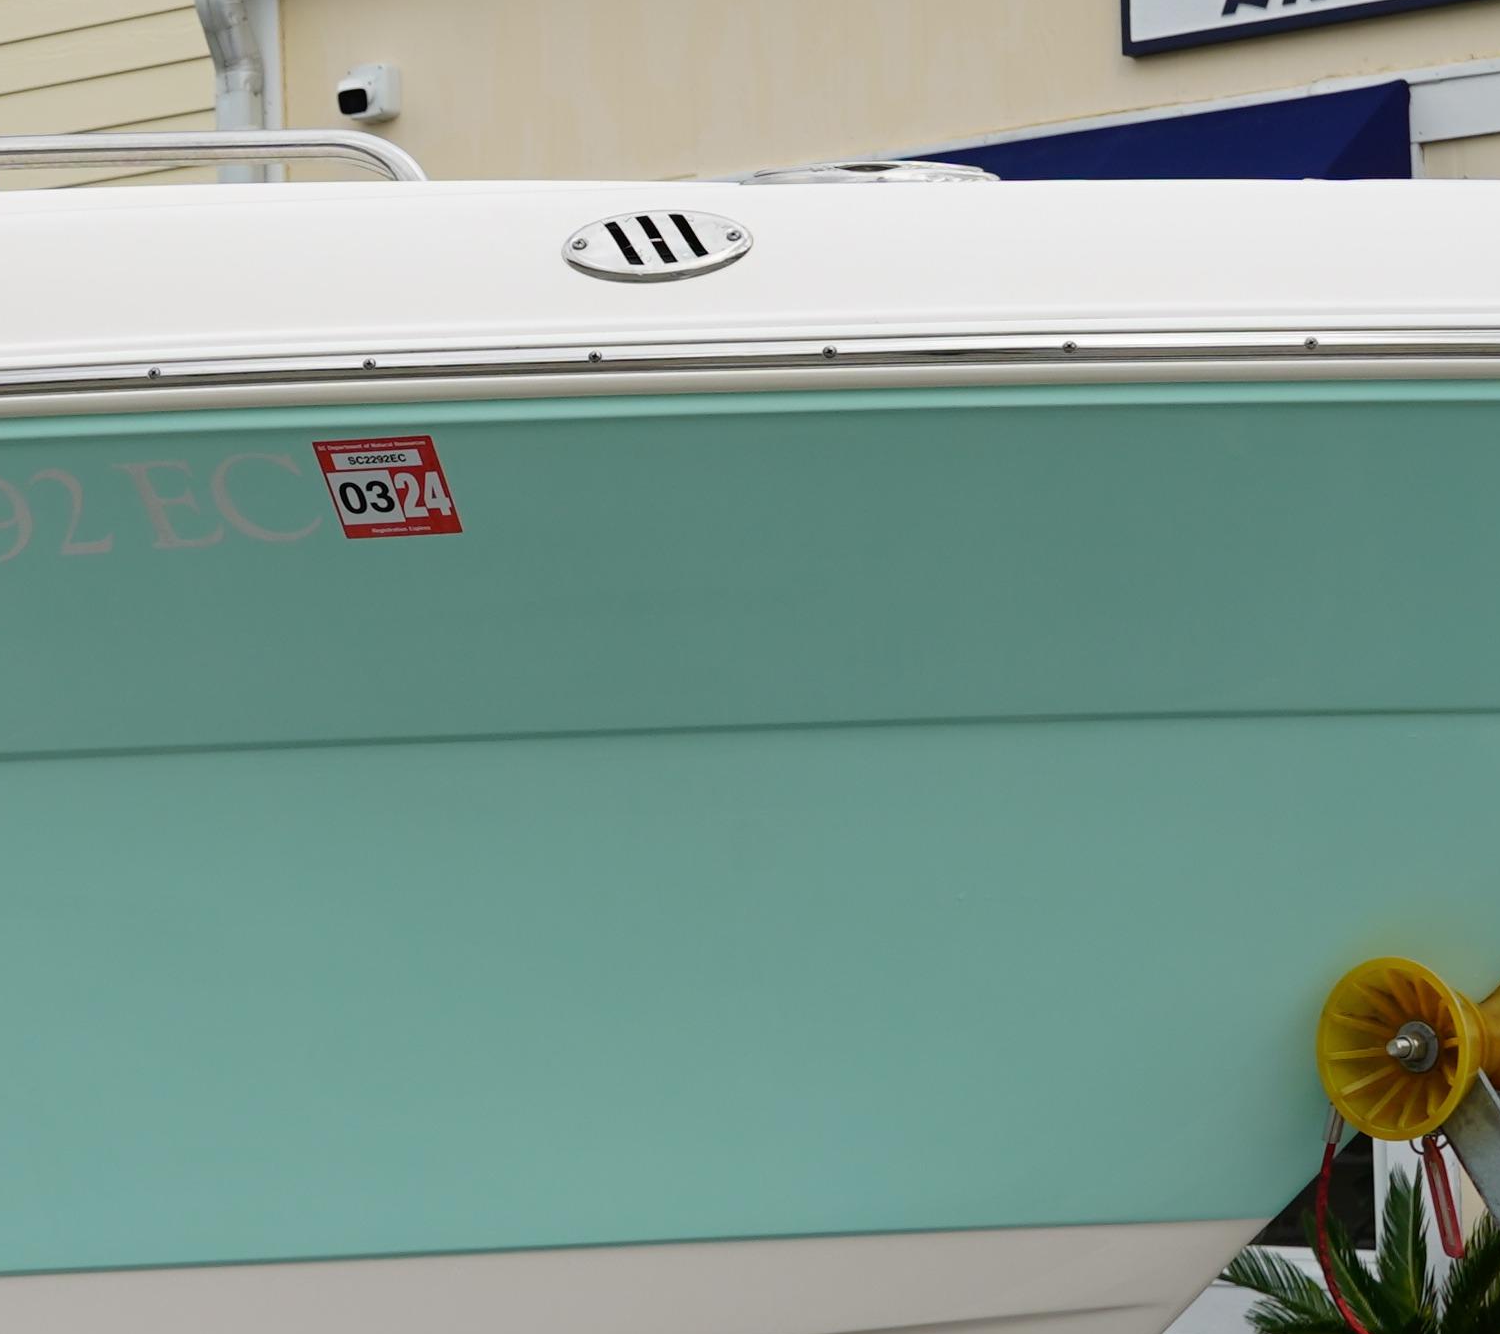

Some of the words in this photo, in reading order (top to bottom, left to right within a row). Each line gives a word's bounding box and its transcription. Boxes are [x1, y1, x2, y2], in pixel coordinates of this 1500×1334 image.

[347, 453, 406, 466] SC2292EC
[111, 453, 324, 551] EC
[339, 481, 396, 515] 03
[394, 470, 452, 518] 24
